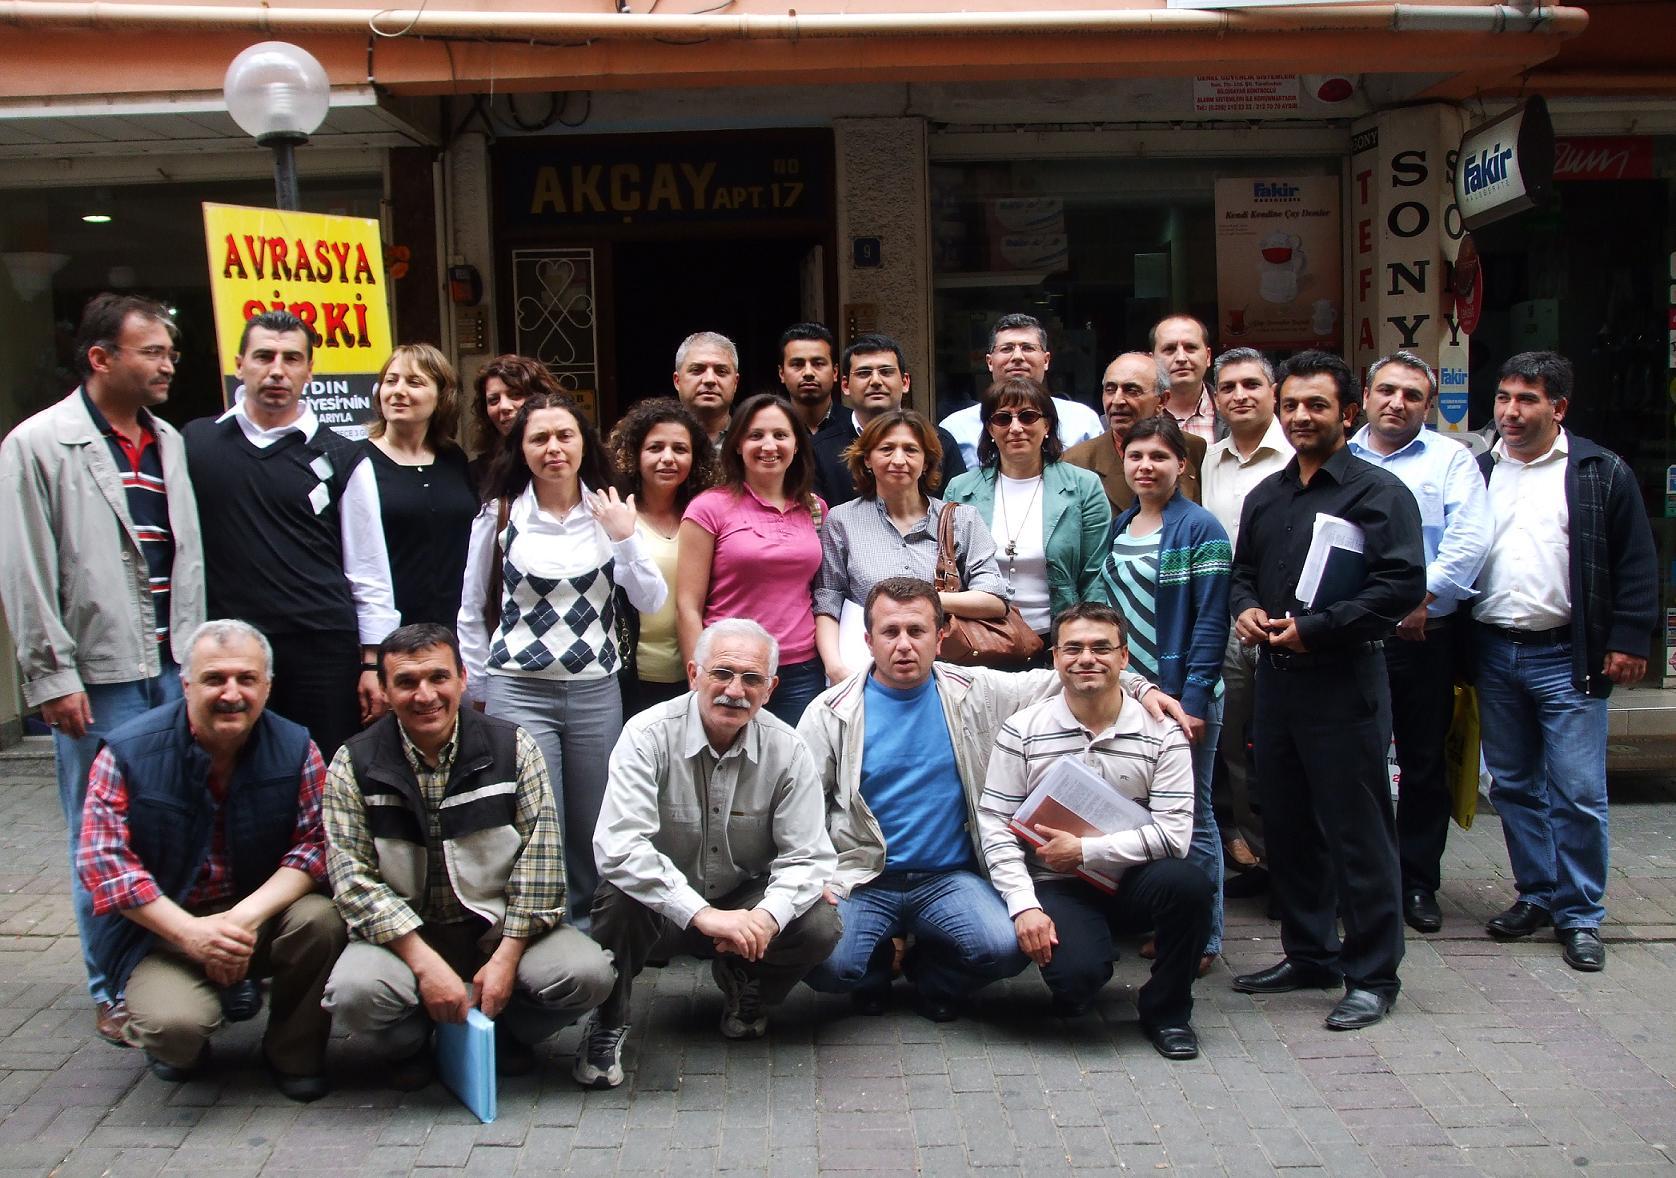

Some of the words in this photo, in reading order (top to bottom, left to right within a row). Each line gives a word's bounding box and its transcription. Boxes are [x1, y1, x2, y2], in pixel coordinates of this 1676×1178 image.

[530, 161, 717, 223] AKÇAY
[770, 182, 804, 208] 17
[773, 158, 799, 174] NO
[1254, 182, 1299, 197] Fakir
[1464, 143, 1512, 195] Fakir
[223, 233, 376, 285] AVRASYA
[1387, 150, 1430, 348] SONY
[1440, 367, 1467, 385] Fakir
